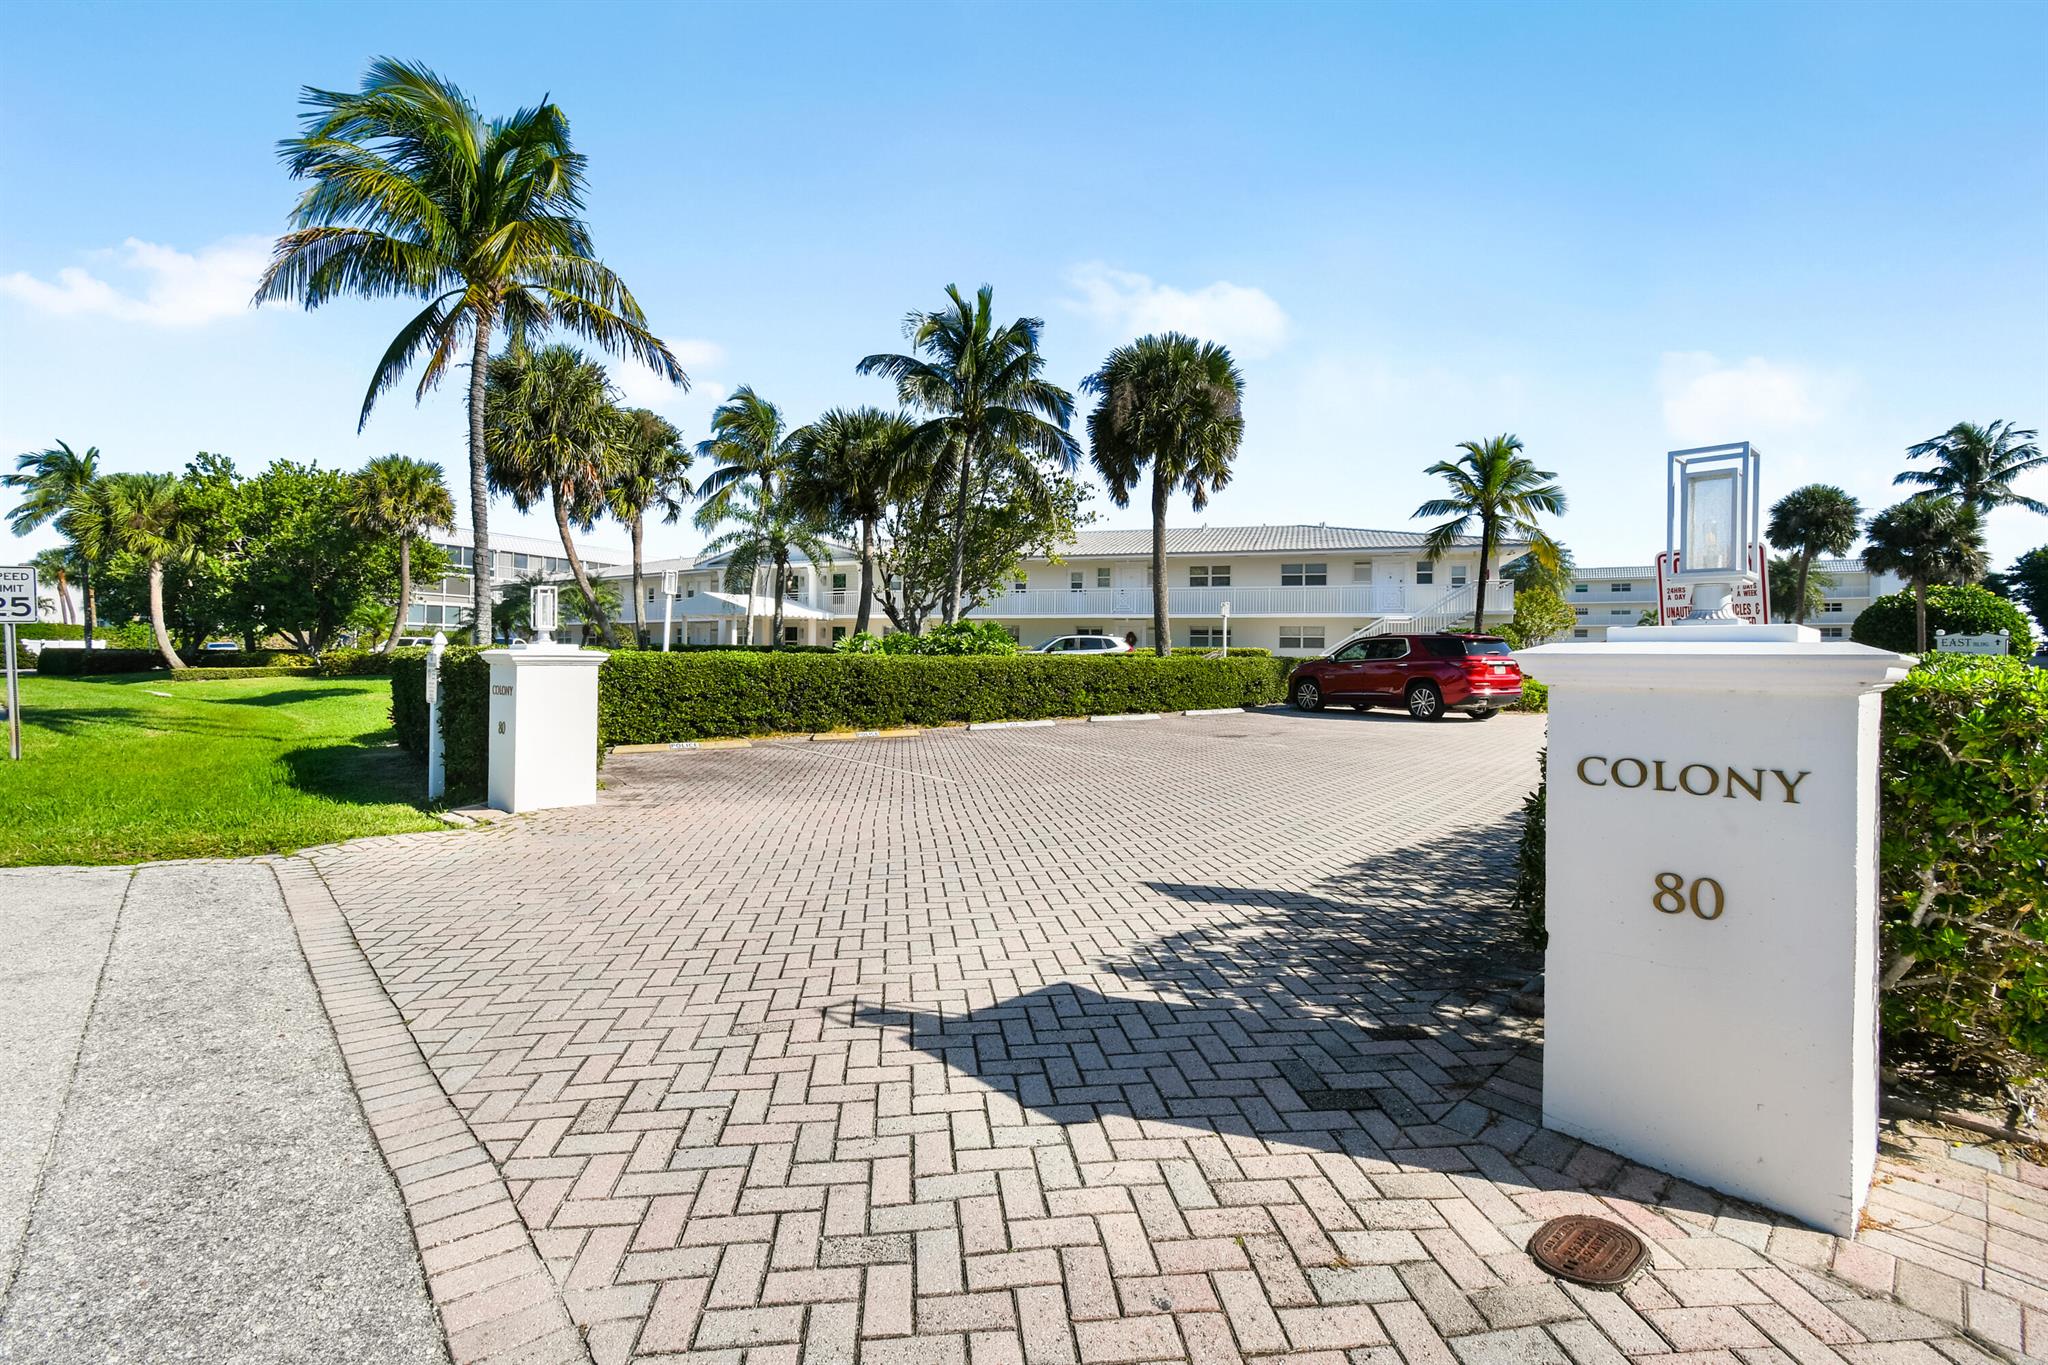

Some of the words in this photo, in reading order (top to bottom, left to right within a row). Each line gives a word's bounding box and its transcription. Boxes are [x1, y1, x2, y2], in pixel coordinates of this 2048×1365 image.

[0, 572, 29, 581] EED
[0, 584, 24, 592] IMIT
[1666, 606, 1693, 618] UNAUTH
[1732, 603, 1751, 615] ICLES
[1755, 602, 1760, 614] &
[1941, 638, 1971, 647] EAST
[492, 684, 514, 696] COLONY
[498, 721, 506, 735] 80
[1576, 756, 1812, 804] COLONY
[1652, 872, 1725, 920] 80
